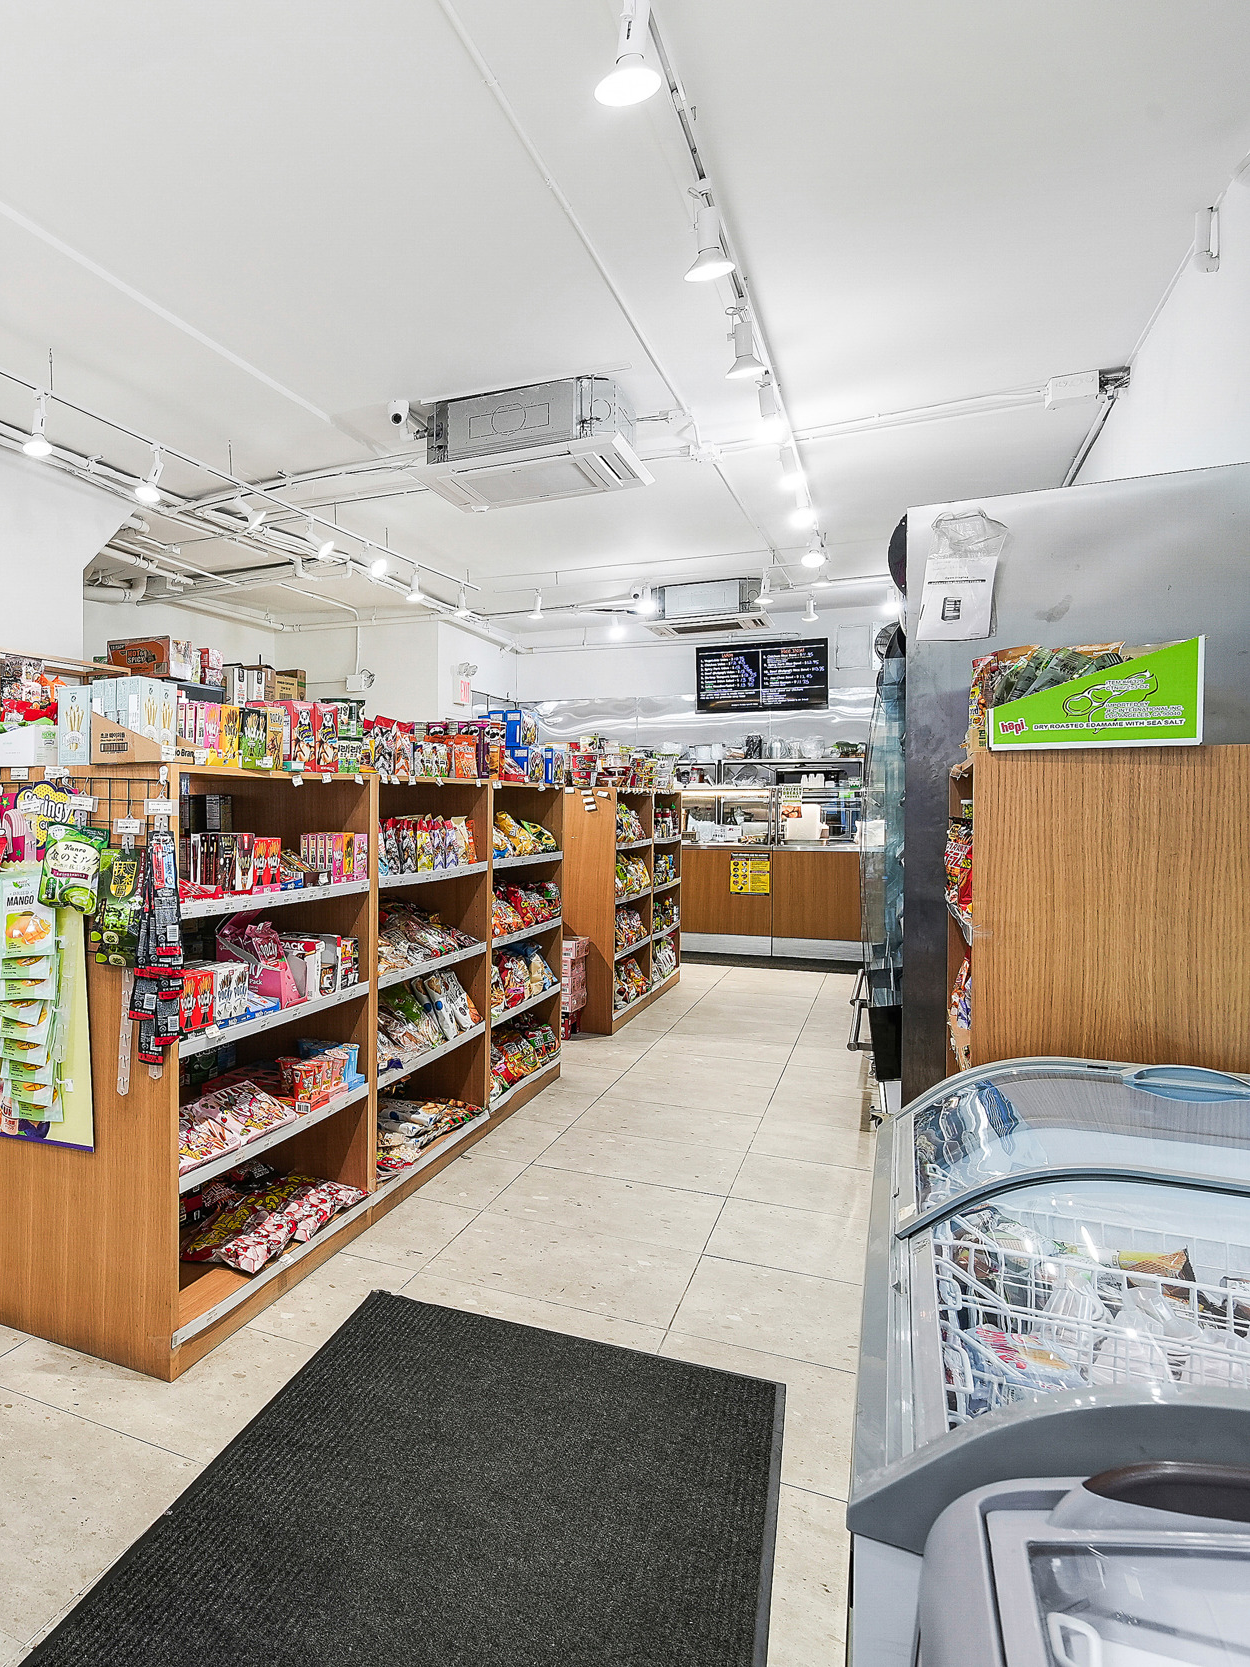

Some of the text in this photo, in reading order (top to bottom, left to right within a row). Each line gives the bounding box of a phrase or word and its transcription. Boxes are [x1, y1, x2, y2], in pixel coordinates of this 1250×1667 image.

[460, 680, 470, 703] EXIT
[64, 843, 87, 854] Kanro
[6, 895, 35, 907] MANGO
